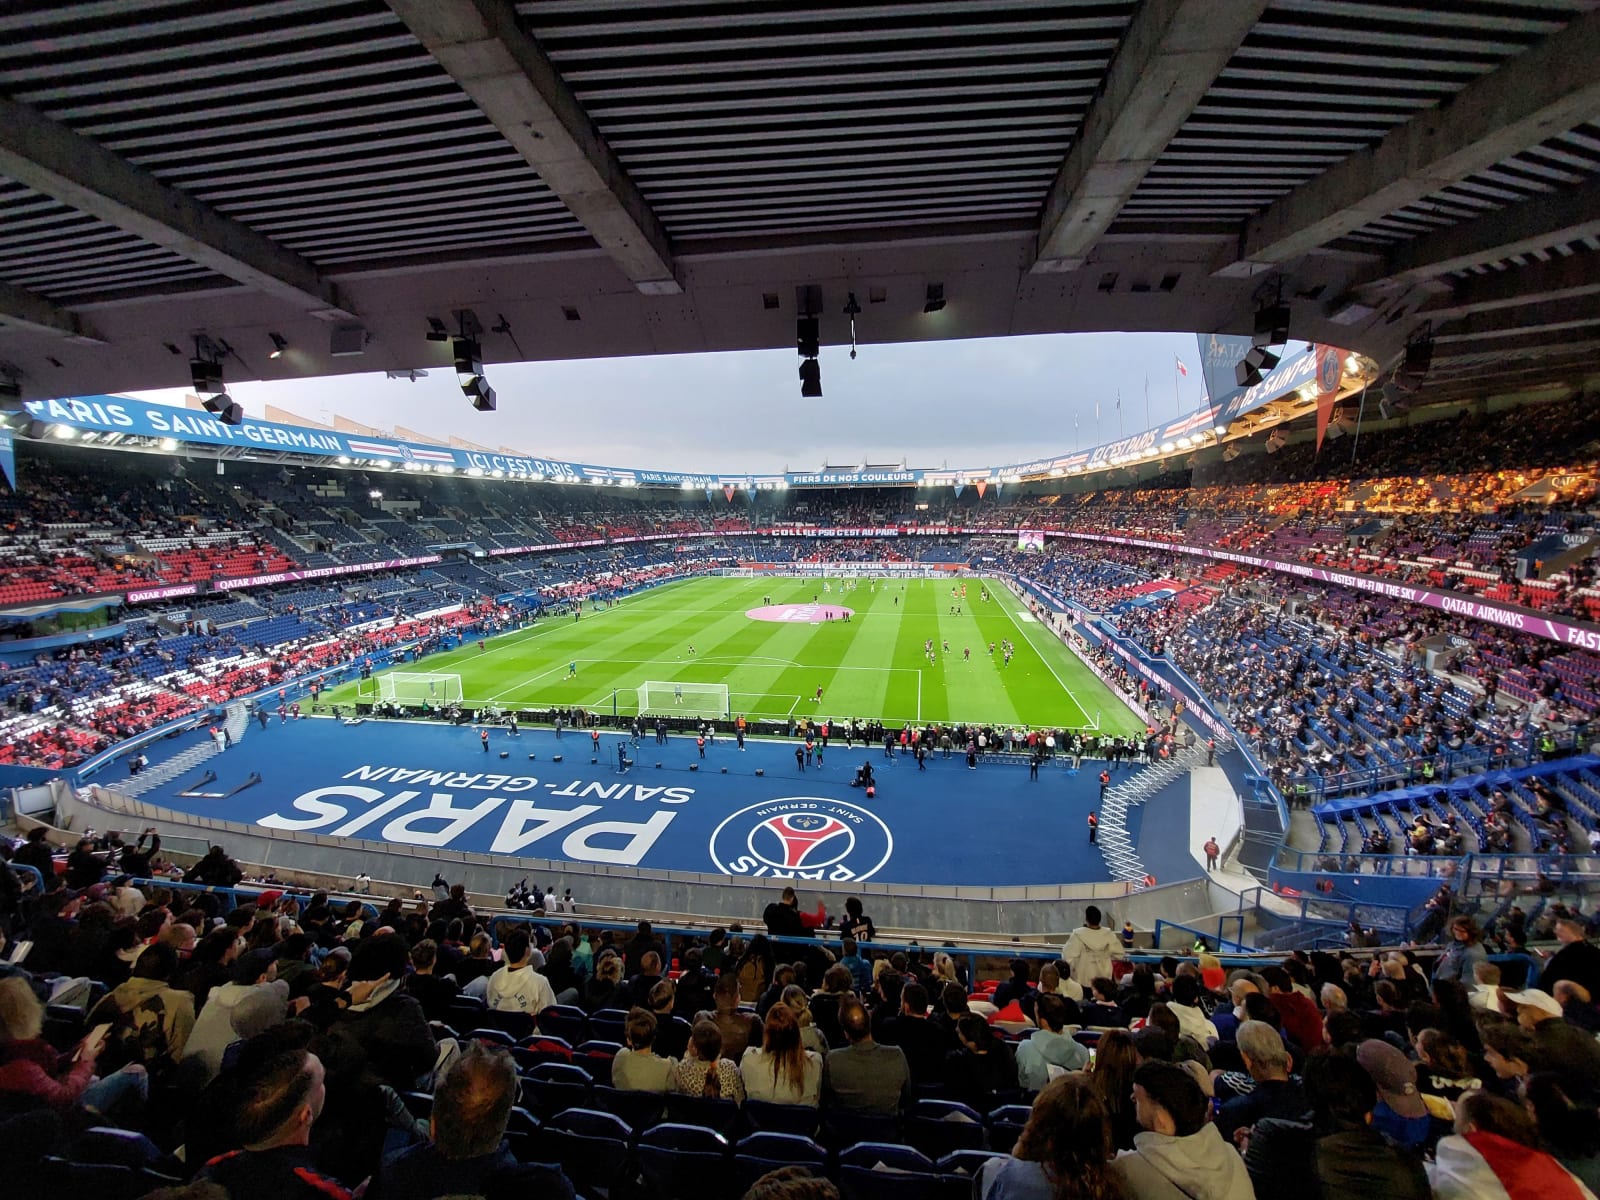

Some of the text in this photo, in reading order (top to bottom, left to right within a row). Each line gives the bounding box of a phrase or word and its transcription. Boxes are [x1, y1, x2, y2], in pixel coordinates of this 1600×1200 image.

[24, 399, 342, 451] PARIS SAINT-GERMAIN
[466, 453, 575, 476] ICI C'EST PARIS
[793, 475, 821, 483] FIERS
[842, 474, 859, 482] NOS
[861, 473, 914, 481] COULEURS
[219, 580, 250, 590] QATAR
[251, 573, 286, 586] AIRWAYS
[303, 567, 334, 578] FASTEST
[335, 565, 353, 574] WI-FI
[374, 561, 386, 569] SKY
[130, 586, 196, 602] QATAR AIRWAYS
[1330, 573, 1356, 587] FASTEST
[1357, 579, 1375, 591] WI-FI
[1375, 582, 1384, 593] IN
[1385, 584, 1399, 596] THE
[1400, 587, 1417, 600] SKY
[1442, 596, 1475, 616] QATAR
[1476, 605, 1524, 629] AIRWAYS
[255, 785, 678, 866] PARIS
